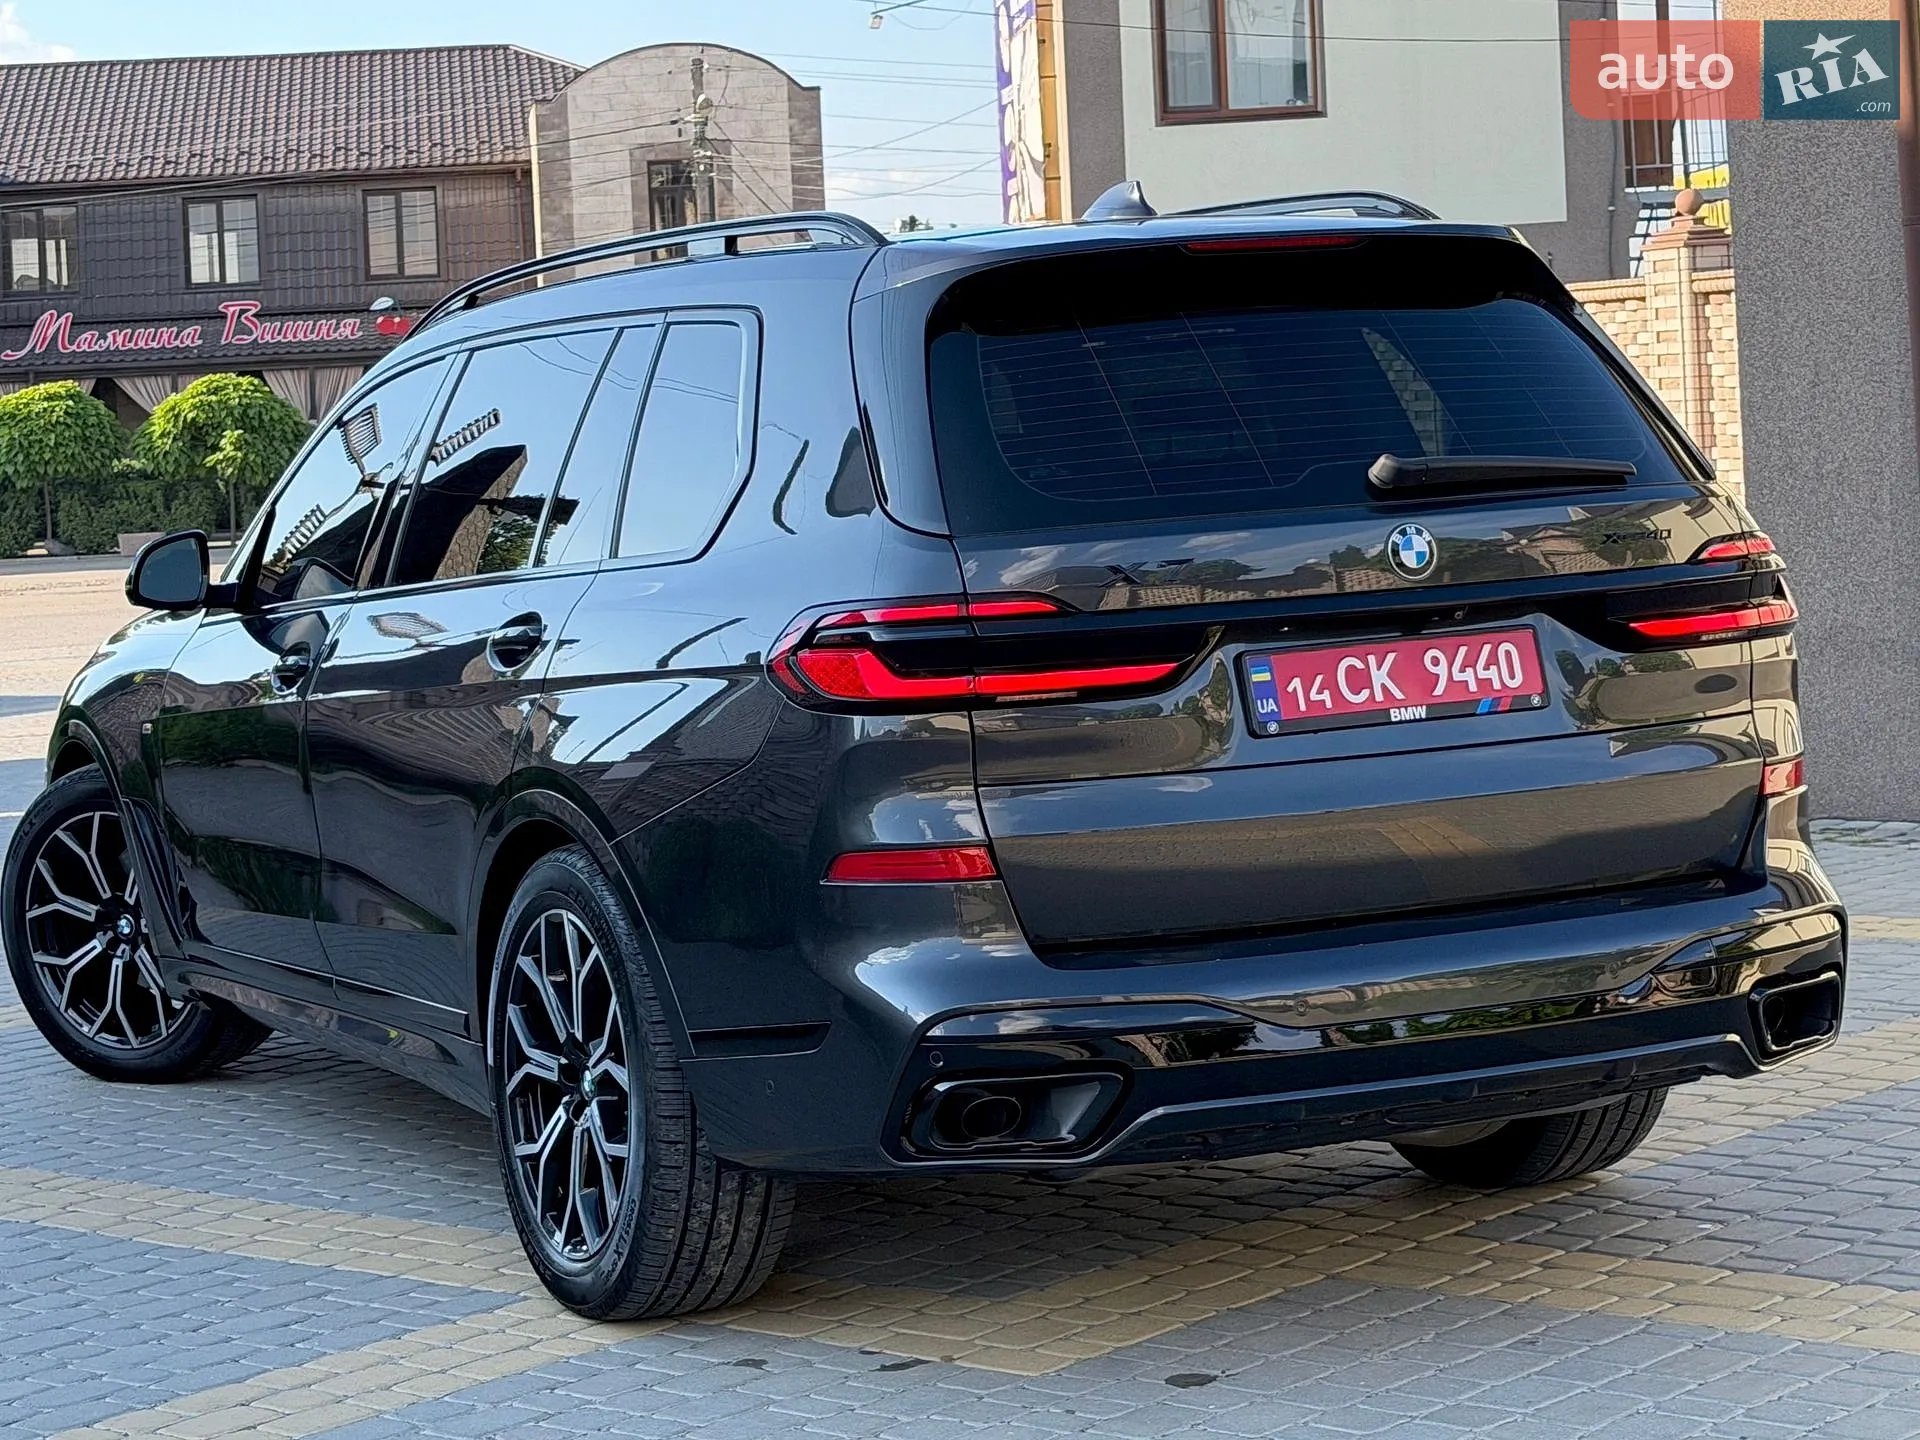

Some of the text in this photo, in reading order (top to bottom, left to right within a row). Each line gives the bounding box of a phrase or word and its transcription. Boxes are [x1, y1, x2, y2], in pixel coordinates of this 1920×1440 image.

[1, 300, 363, 360] Мамина Вишня
[1423, 642, 1523, 696] 9440
[1256, 697, 1279, 714] UA
[1389, 705, 1427, 722] BMW
